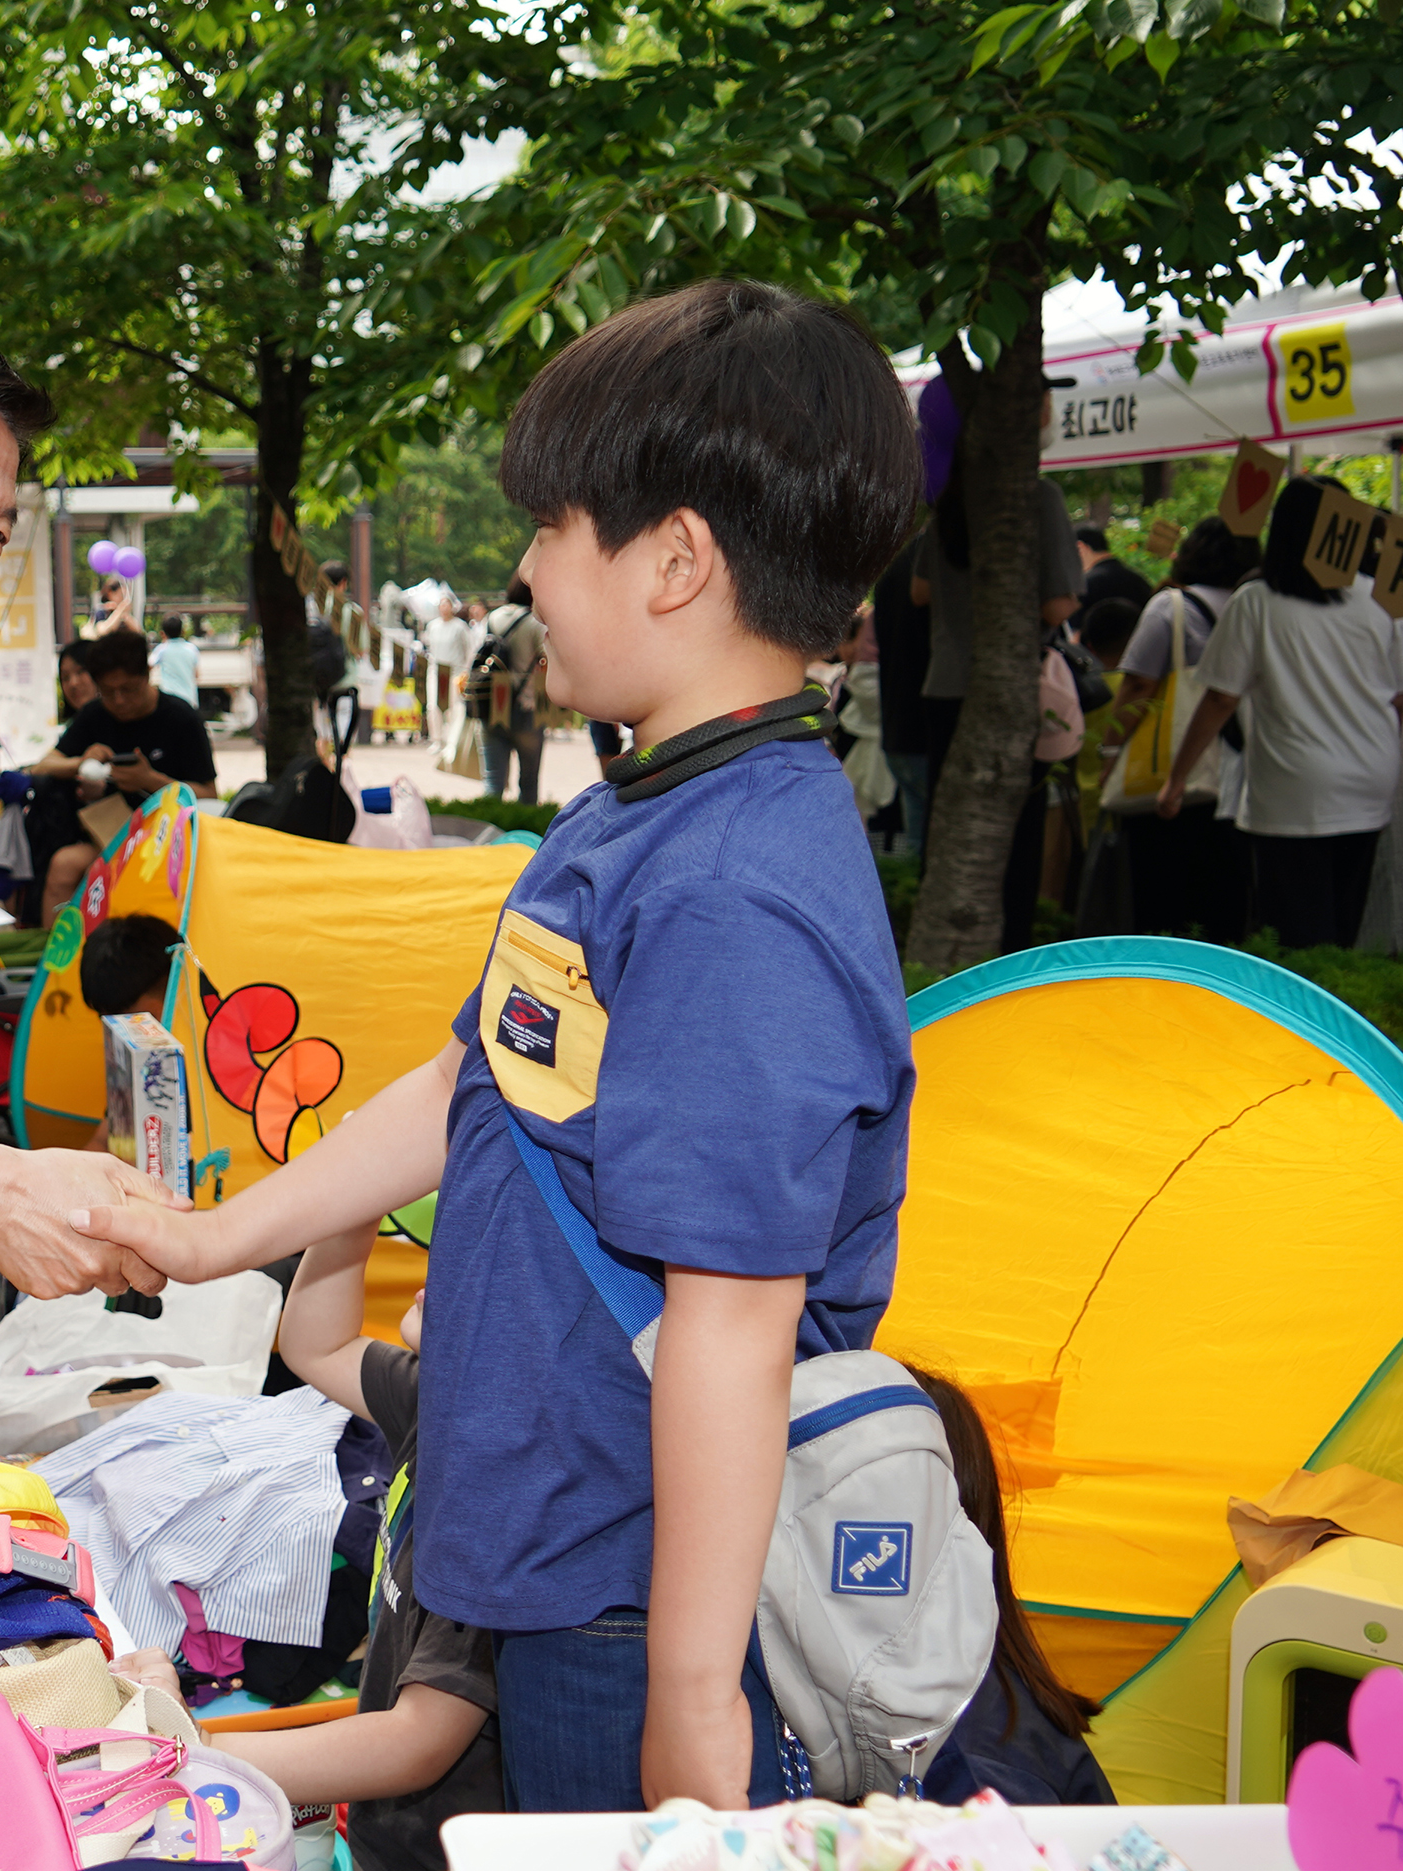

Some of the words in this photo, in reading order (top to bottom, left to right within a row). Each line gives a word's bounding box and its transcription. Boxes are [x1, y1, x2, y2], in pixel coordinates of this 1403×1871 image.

[1290, 342, 1348, 403] 35
[1061, 394, 1138, 441] 최고야
[1314, 512, 1361, 573] 세
[146, 1116, 161, 1178] UILDERZ
[848, 1535, 898, 1582] FILA
